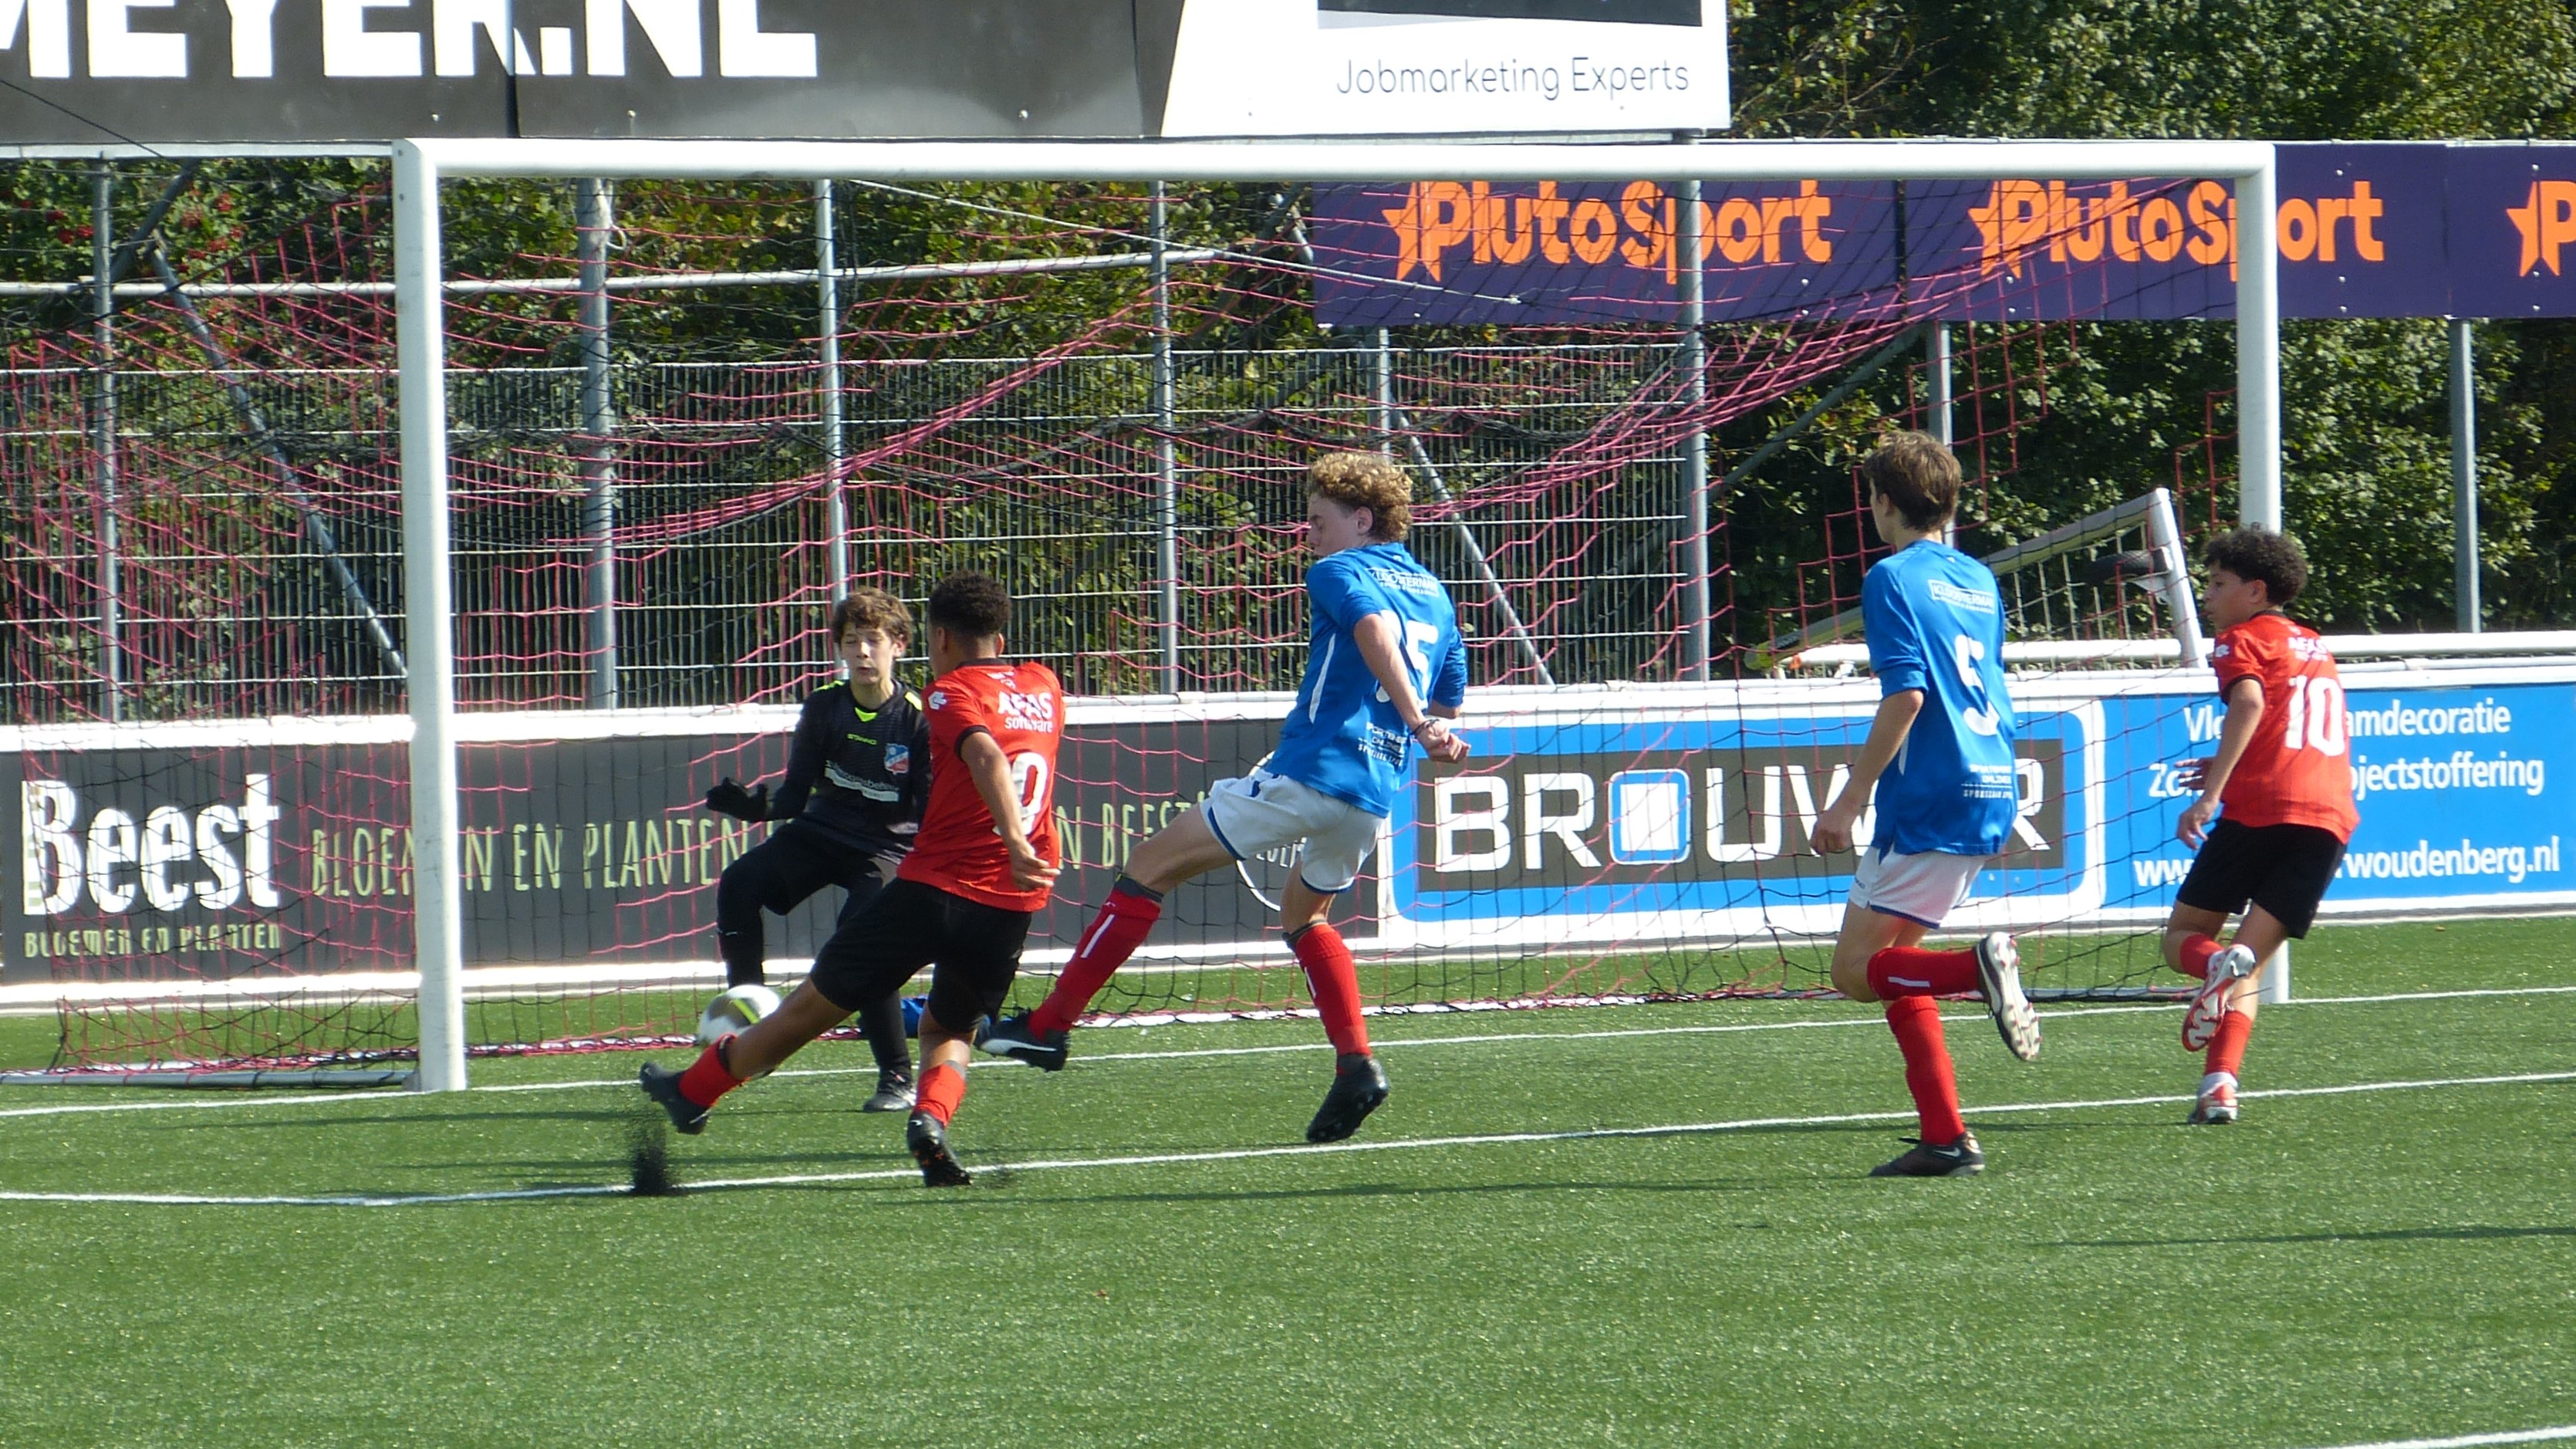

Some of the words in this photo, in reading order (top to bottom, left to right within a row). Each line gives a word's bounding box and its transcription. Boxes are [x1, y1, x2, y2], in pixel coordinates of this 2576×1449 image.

[1336, 59, 1559, 101] Jobmarketing
[1572, 56, 1690, 100] Experts
[1994, 180, 2385, 282] PlutoSort
[998, 691, 1053, 719] AFAS
[1954, 633, 2000, 736] 5
[2285, 674, 2345, 757] 10
[2345, 697, 2512, 738] amdecoratie
[22, 773, 280, 915] Beest
[1434, 758, 2051, 873] BROUWR
[312, 825, 495, 897] BLOEN
[512, 822, 564, 891] EN
[583, 818, 748, 890] PLANTEN
[24, 929, 131, 958] BLOEMEN
[141, 927, 169, 954] EN
[180, 924, 280, 952] PLANTEN
